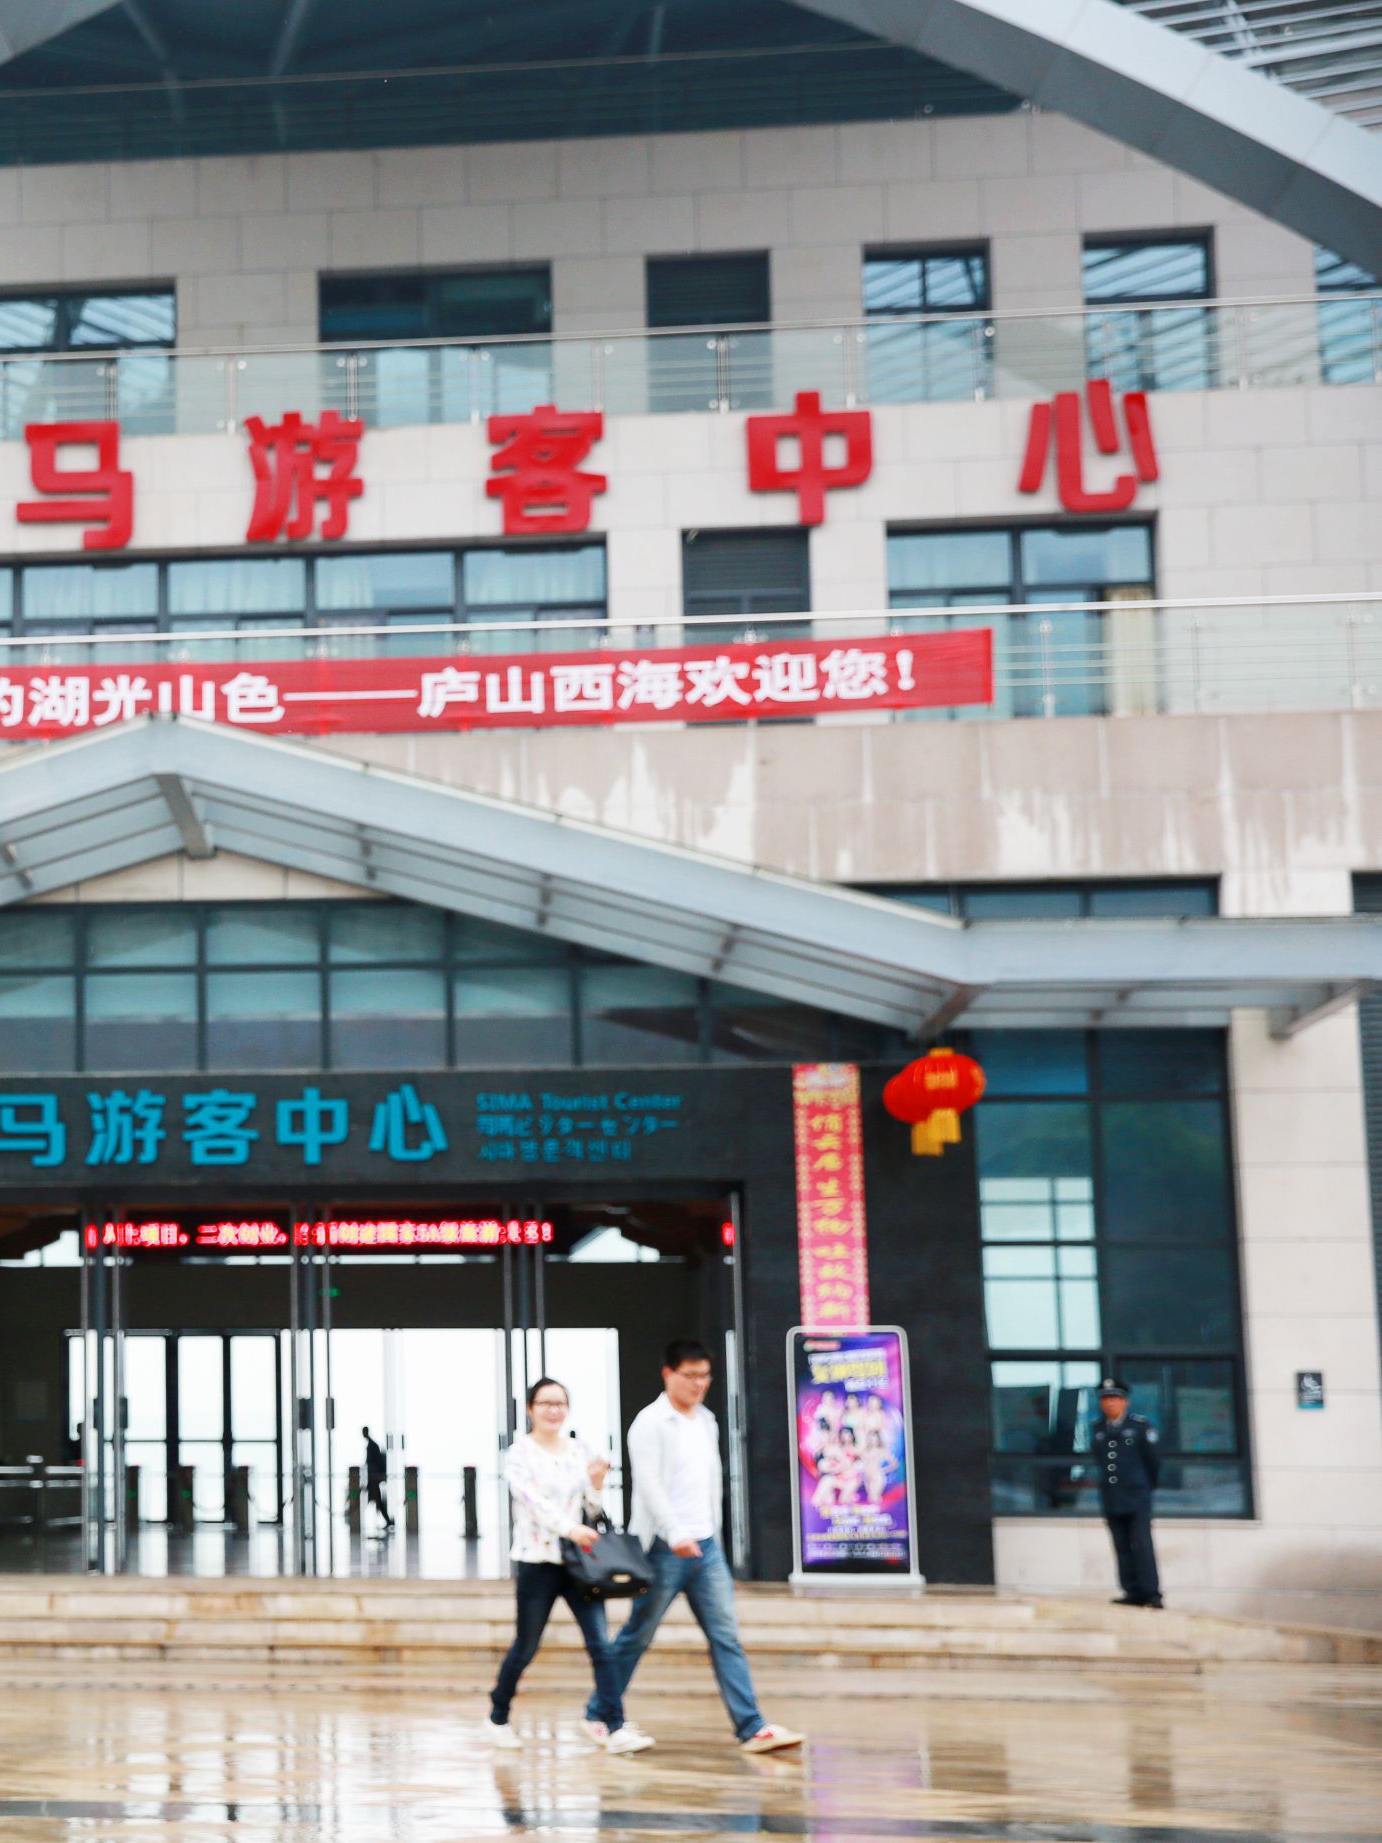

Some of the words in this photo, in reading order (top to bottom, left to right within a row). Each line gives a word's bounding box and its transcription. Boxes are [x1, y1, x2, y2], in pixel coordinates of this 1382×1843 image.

[475, 1091, 533, 1111] SIMA
[540, 1092, 609, 1111] Tourist
[614, 1091, 682, 1111] Center
